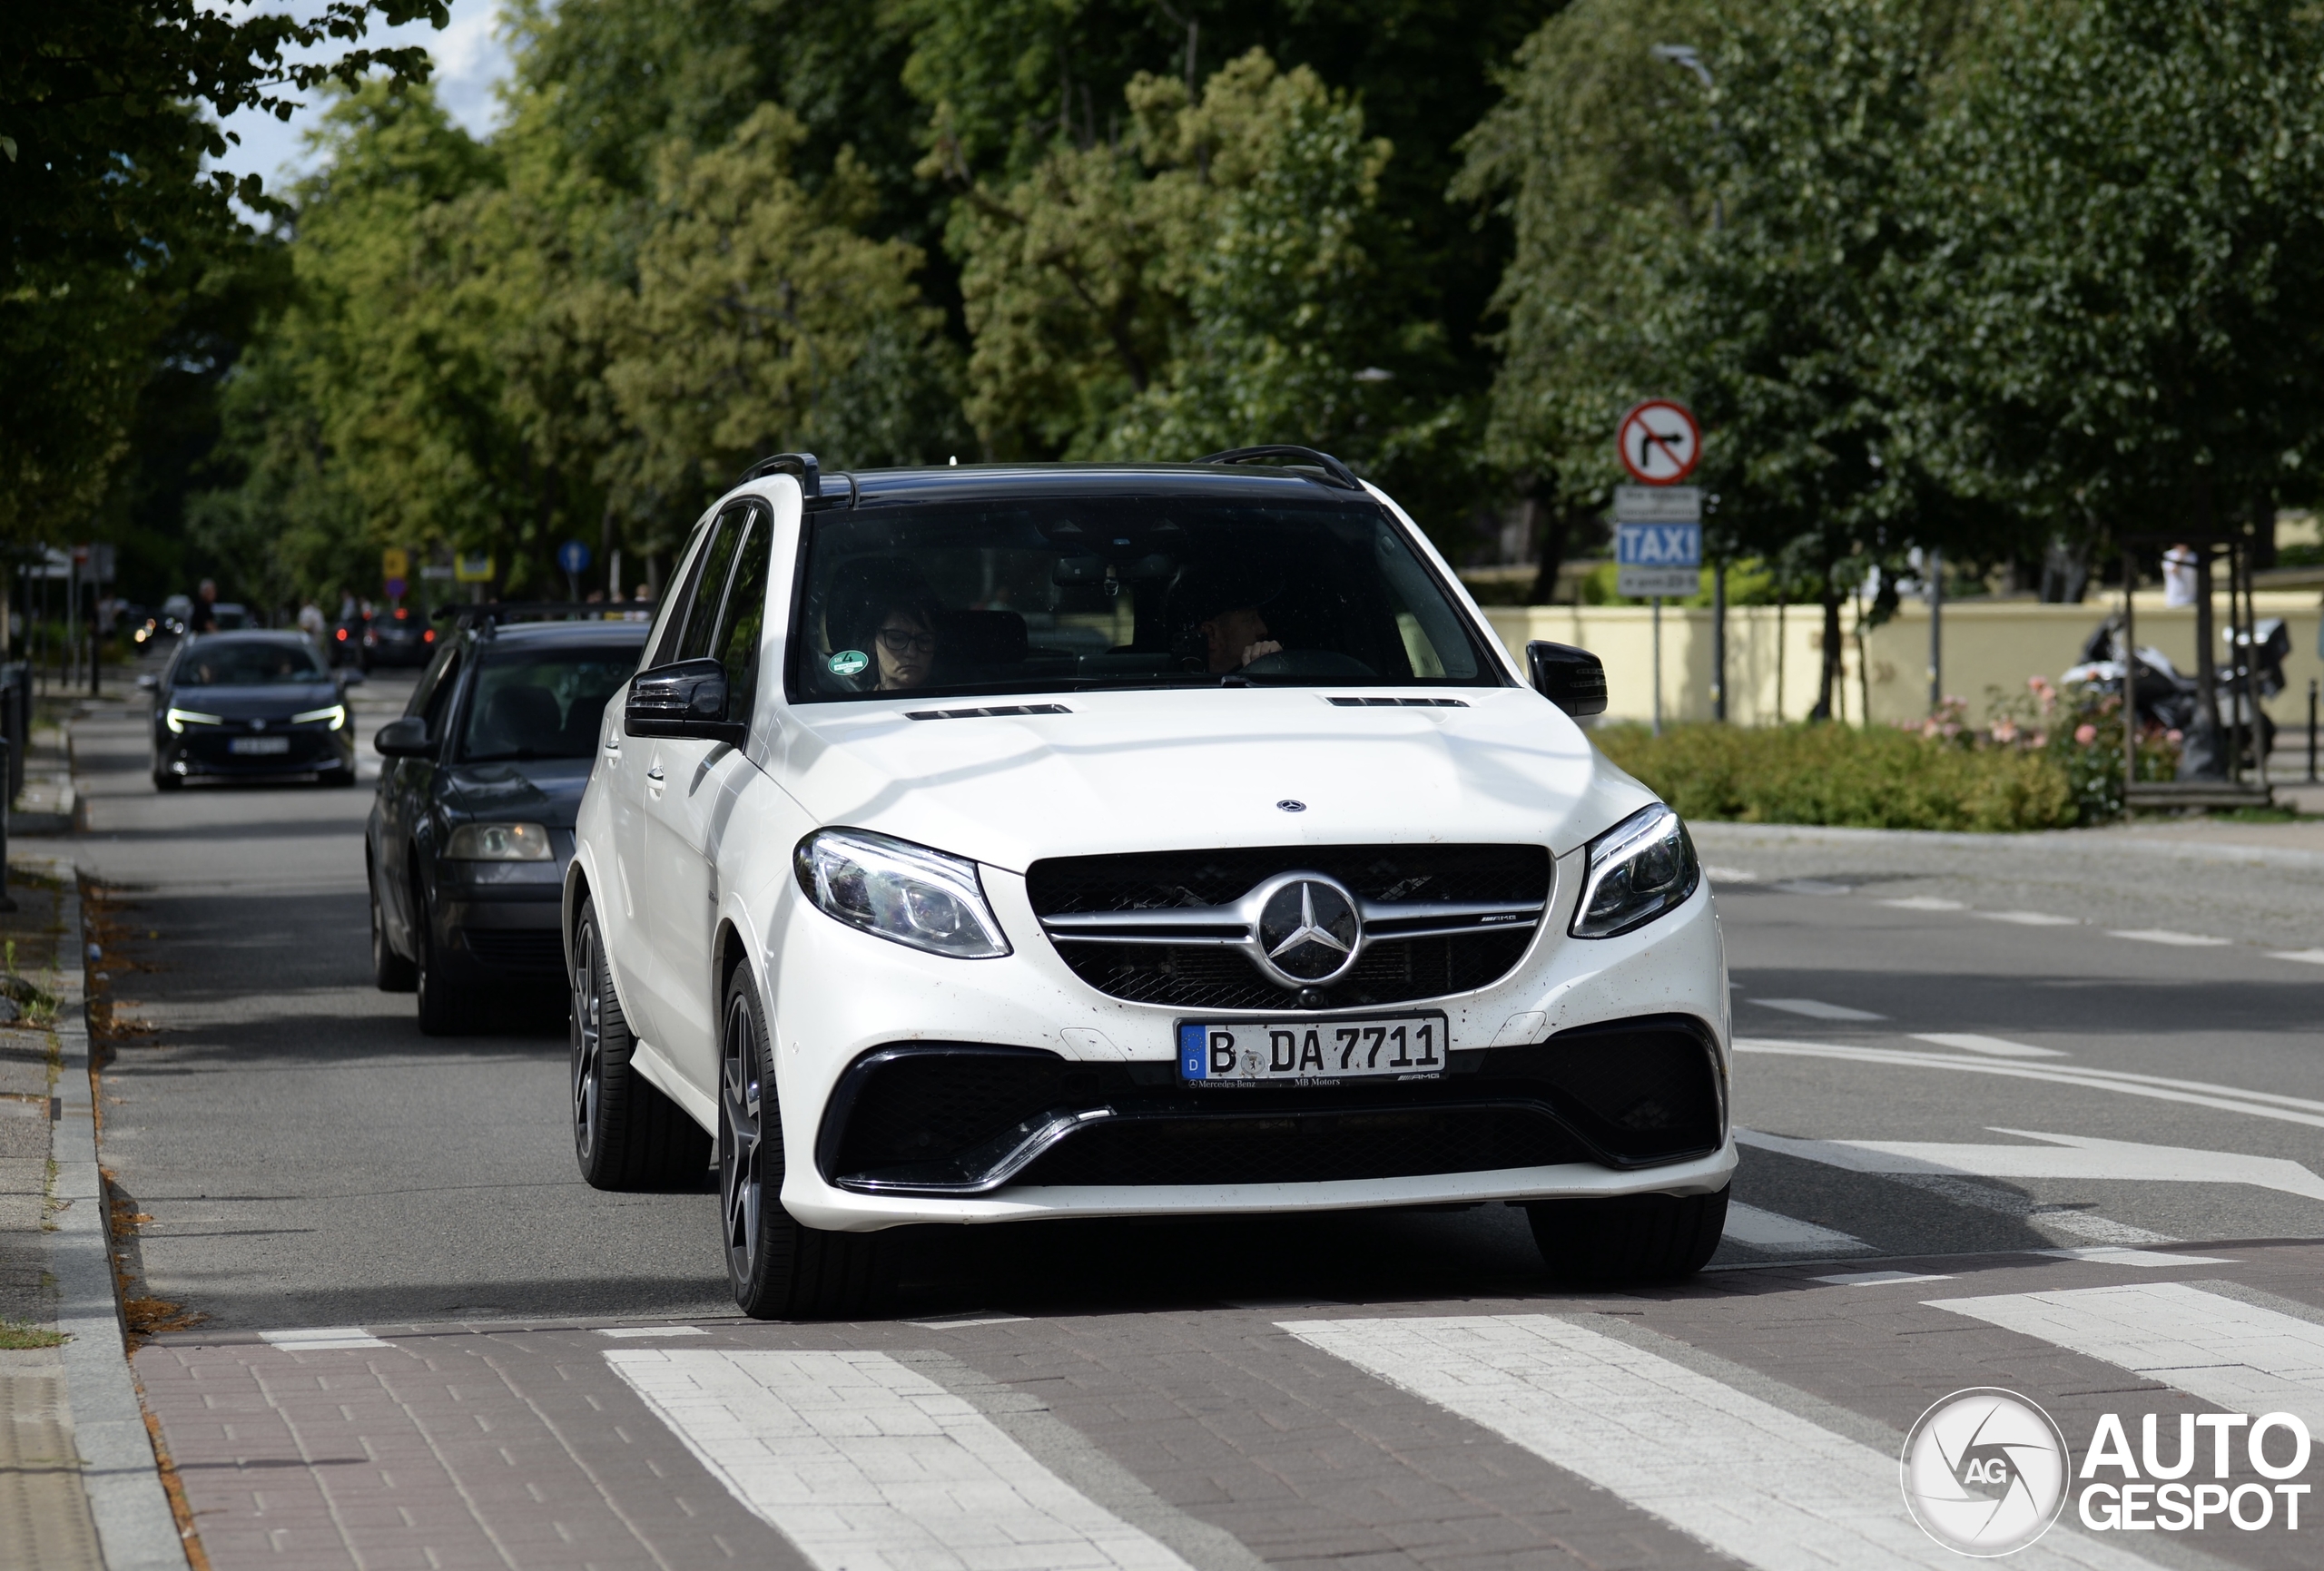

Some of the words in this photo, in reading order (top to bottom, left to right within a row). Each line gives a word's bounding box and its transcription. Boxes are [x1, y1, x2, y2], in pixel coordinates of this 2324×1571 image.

[1621, 528, 1698, 561] TAXI
[842, 653, 853, 663] 4
[1209, 1031, 1236, 1073] B
[1269, 1029, 1324, 1071] DA
[1336, 1024, 1439, 1069] 7711
[1188, 1059, 1198, 1071] D
[1198, 1080, 1256, 1088] Mercedes-Benz
[1295, 1078, 1309, 1087] MB
[1311, 1077, 1341, 1086] Motors
